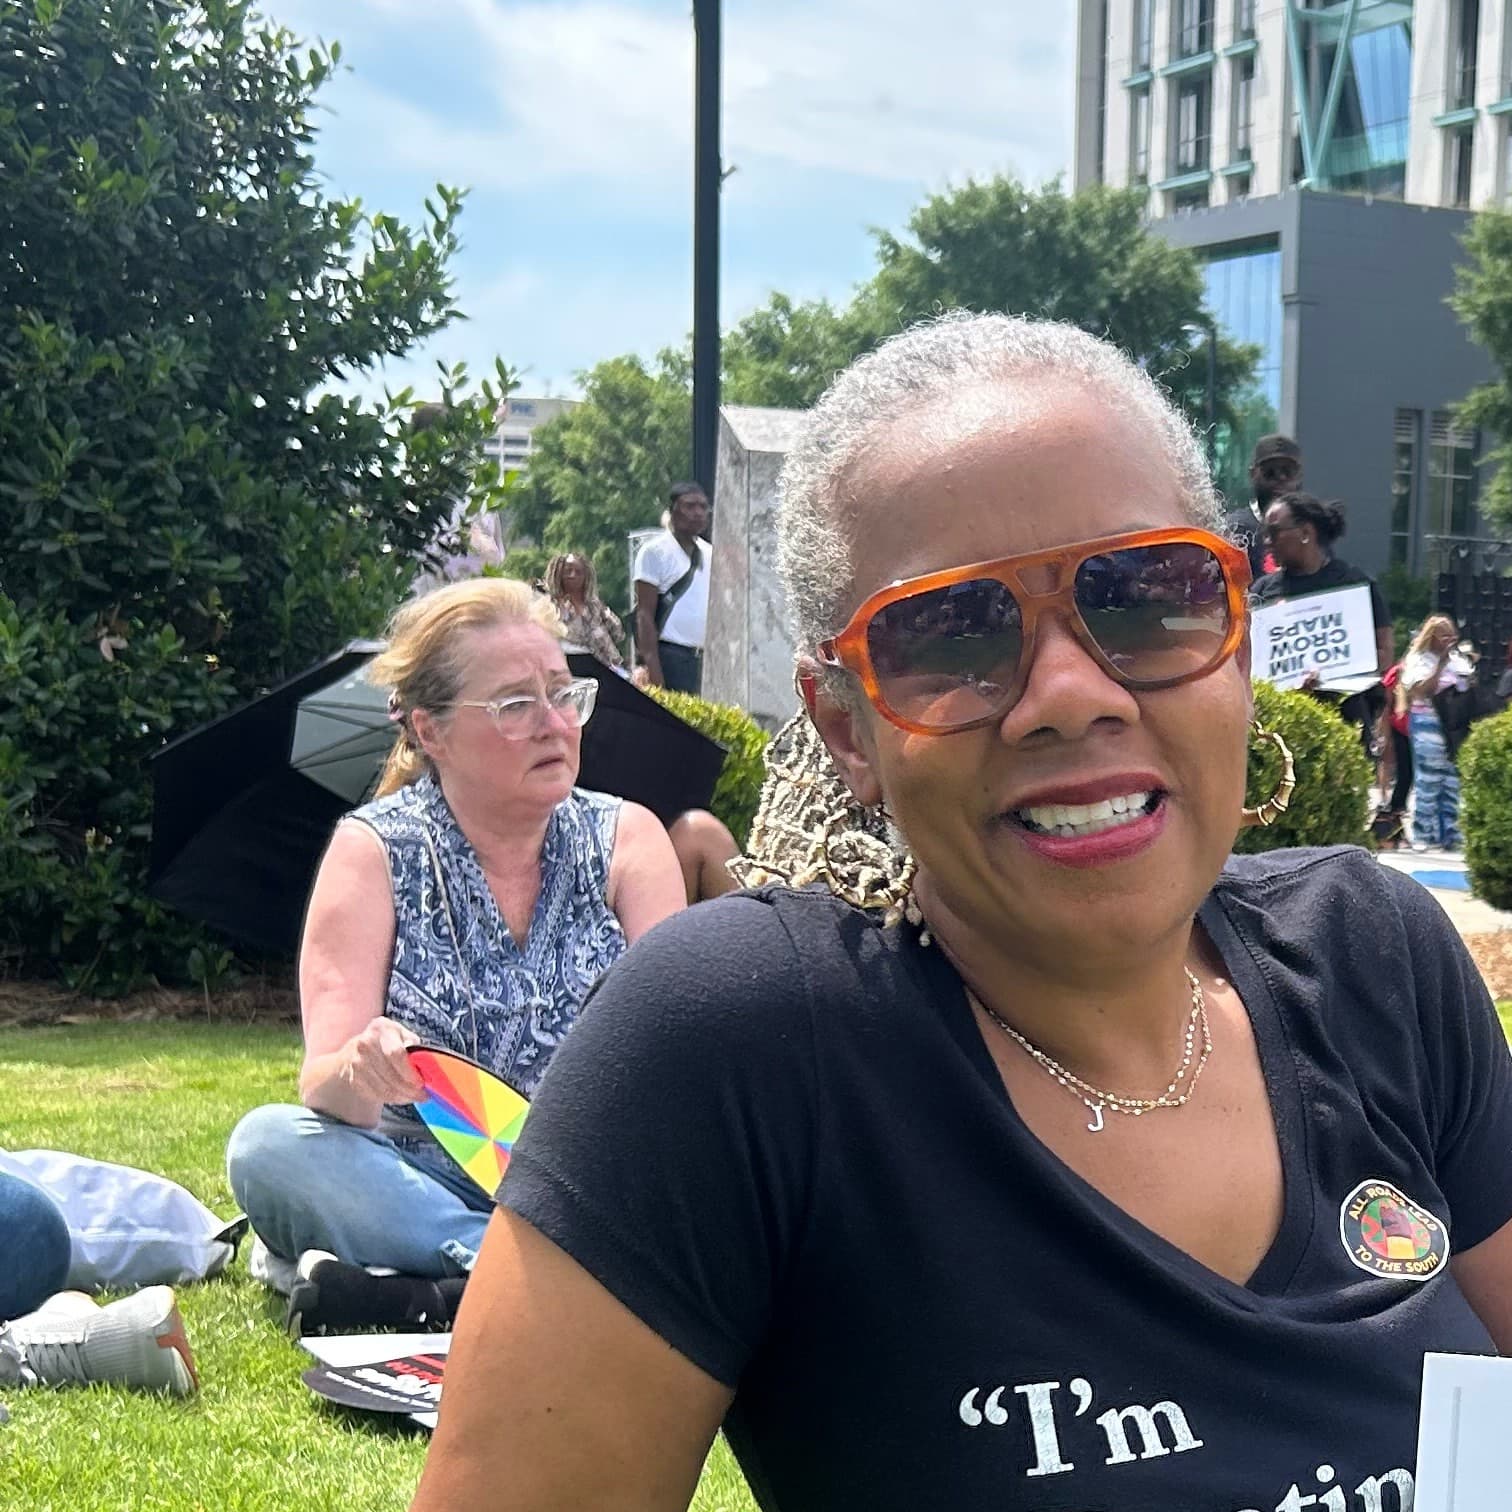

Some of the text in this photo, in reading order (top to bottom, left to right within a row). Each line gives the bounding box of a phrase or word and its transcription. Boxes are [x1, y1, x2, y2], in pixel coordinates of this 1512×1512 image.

[1269, 612, 1343, 642] MAPS
[1270, 628, 1347, 660] CROW
[1270, 644, 1350, 676] NO JIM
[1349, 1197, 1369, 1220] ALL
[1408, 1206, 1438, 1231] LEAD
[1355, 1245, 1438, 1272] TO THE SOUTH
